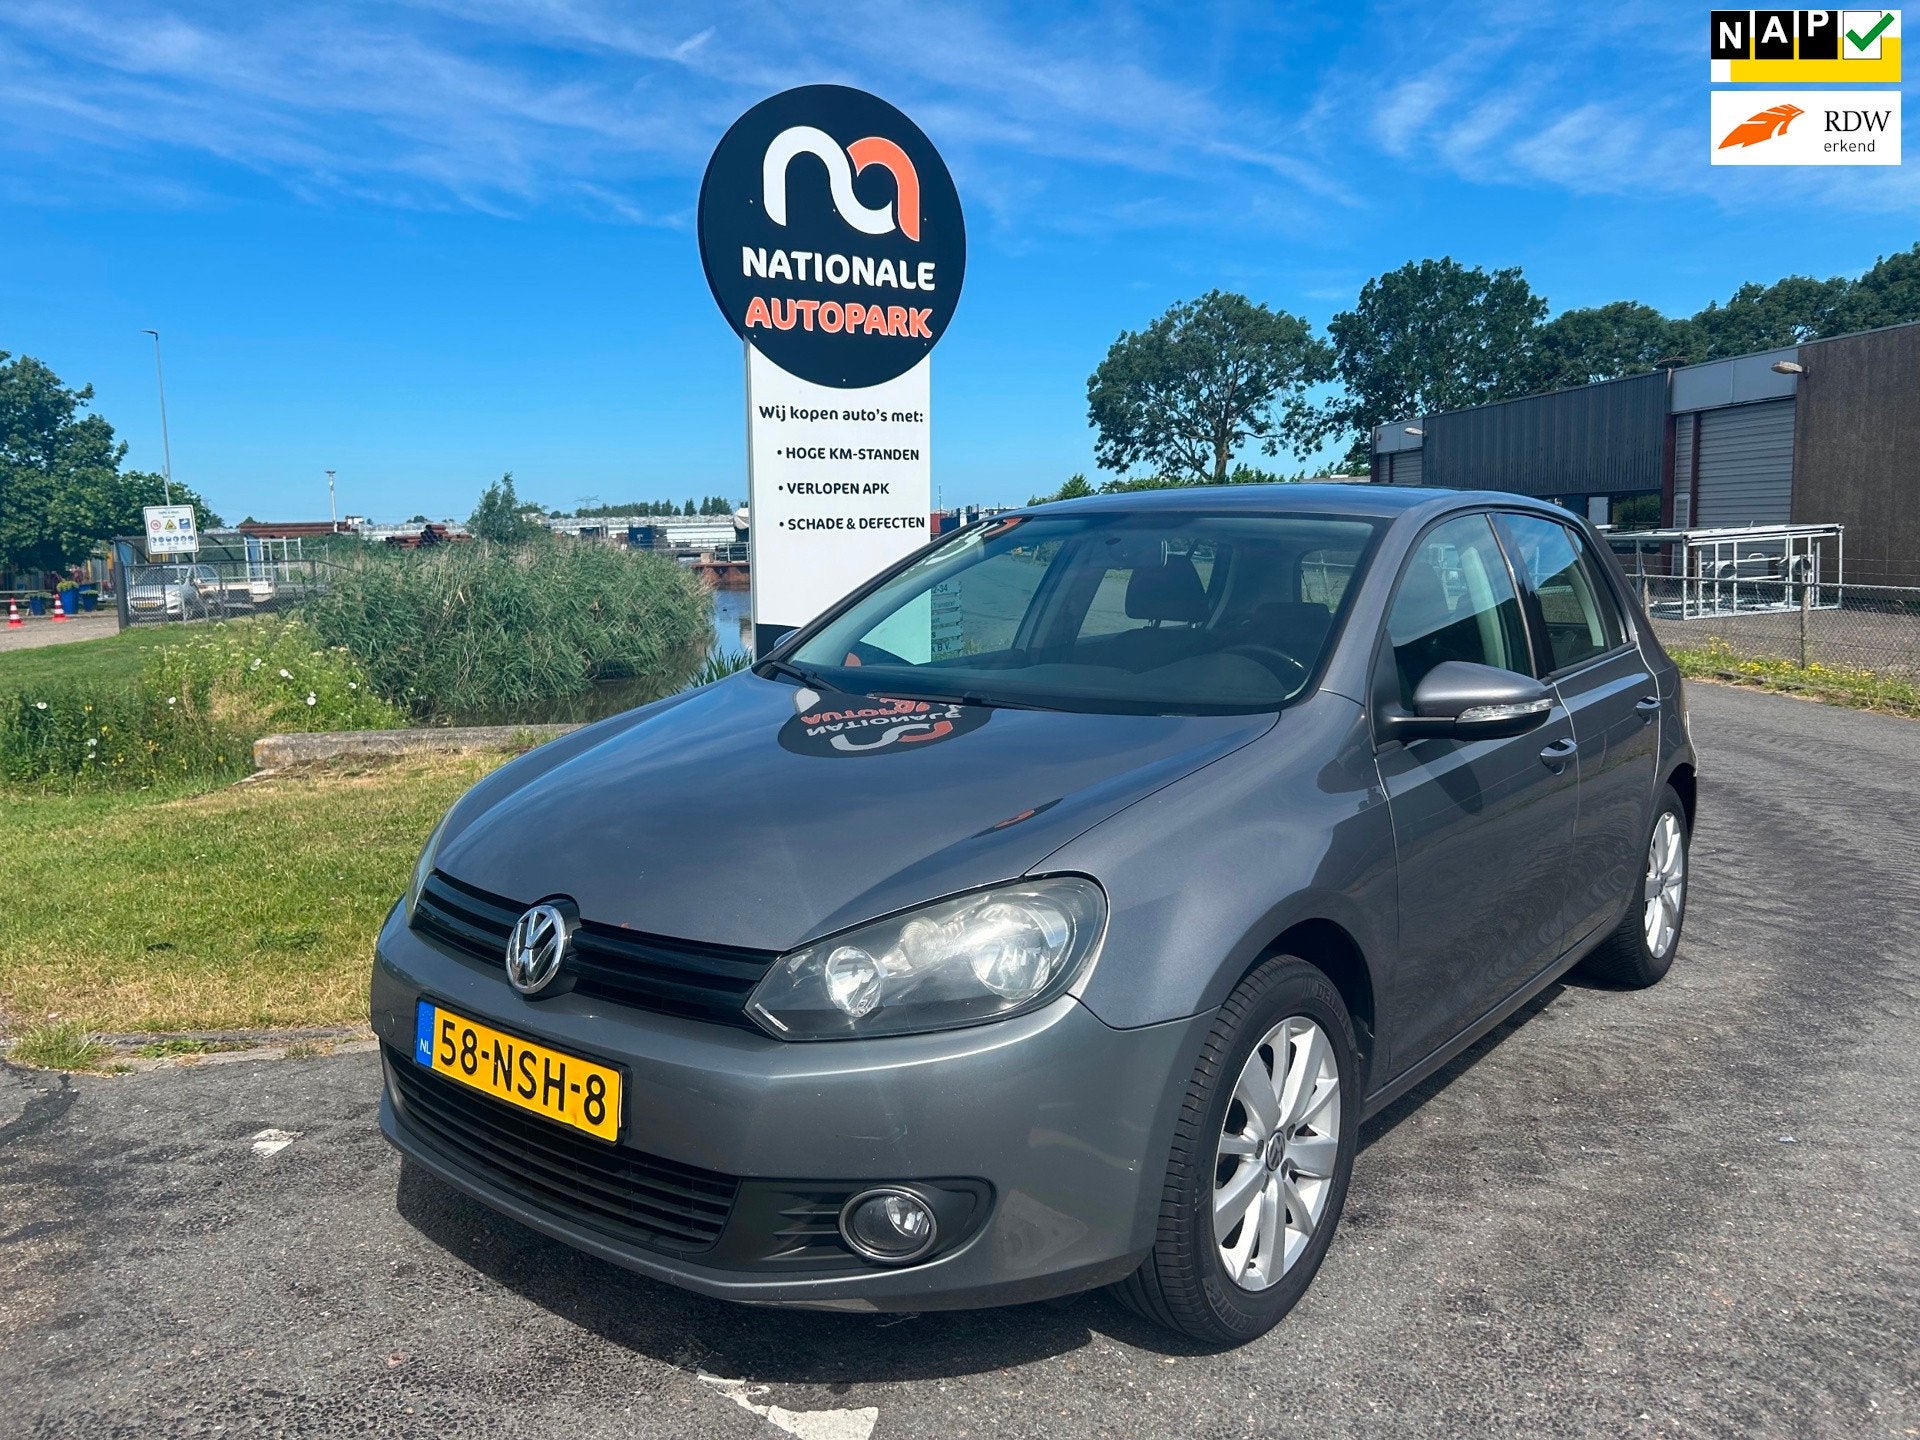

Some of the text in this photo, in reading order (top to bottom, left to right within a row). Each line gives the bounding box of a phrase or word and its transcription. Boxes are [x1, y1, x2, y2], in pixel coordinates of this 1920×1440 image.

[742, 246, 936, 291] NATIONALE
[745, 296, 933, 339] AUTOPARK
[759, 405, 924, 423] Wij kopen auto's met:
[785, 447, 920, 461] HOGE KM-STANDEN
[787, 482, 890, 495] VERLOPEN APK
[788, 517, 925, 530] SCHADE & DEFECTEN
[419, 1038, 432, 1056] NL
[440, 1018, 607, 1126] 58-NSH-8
